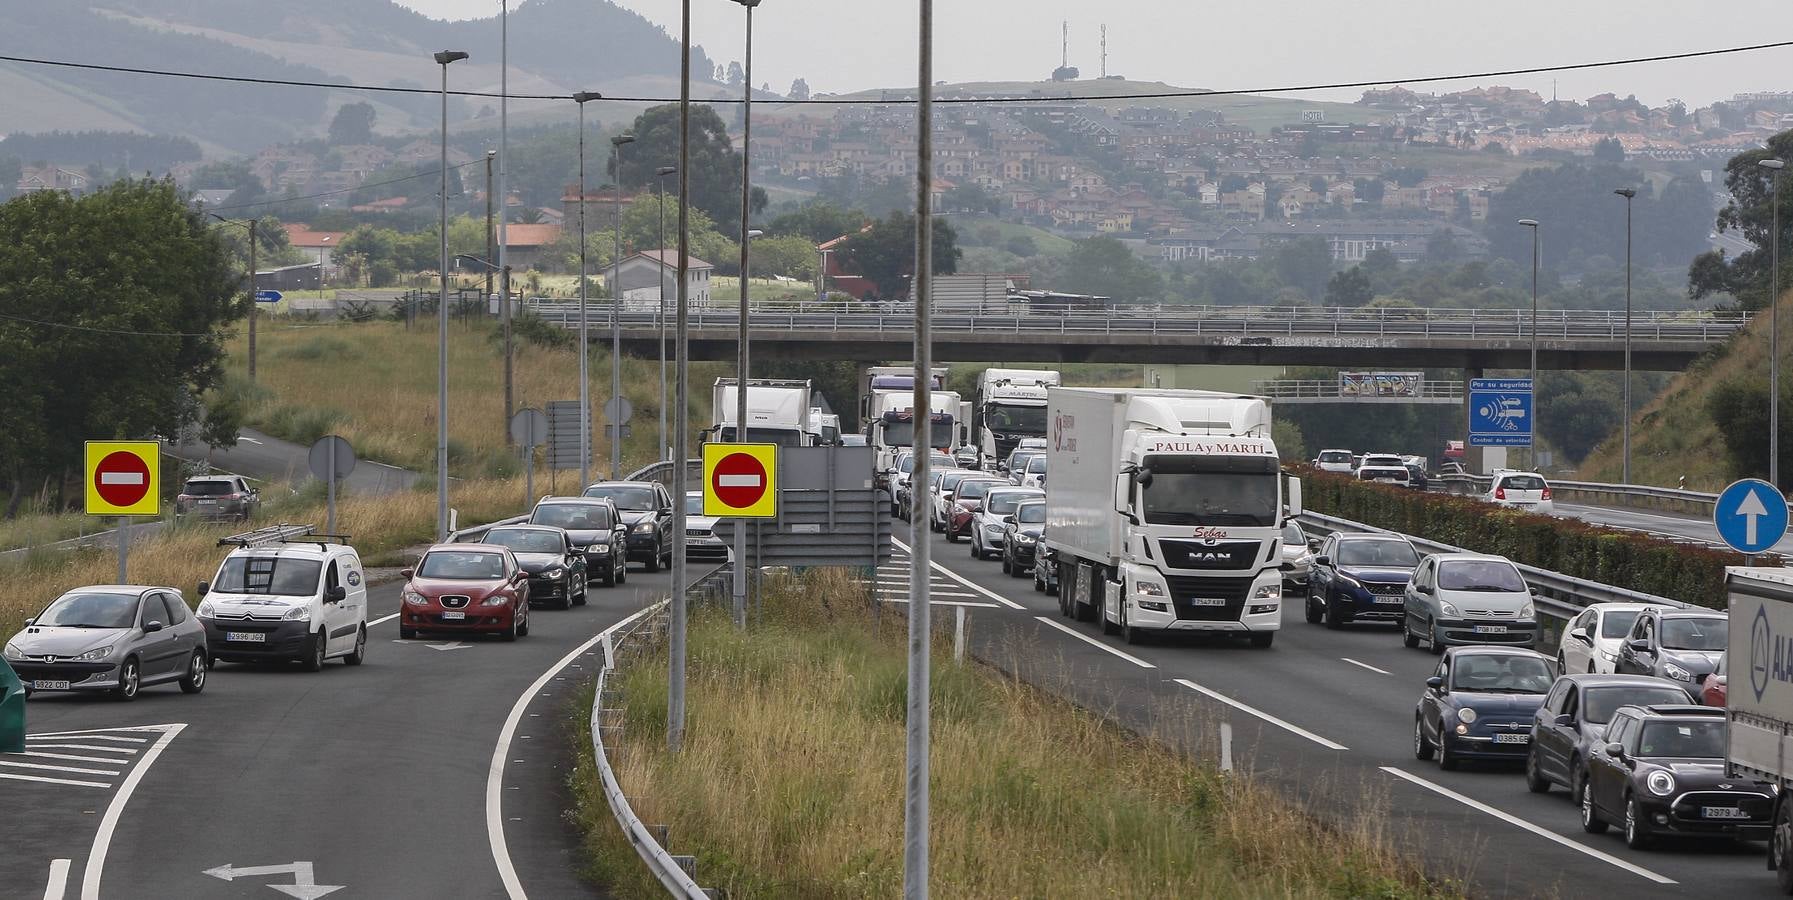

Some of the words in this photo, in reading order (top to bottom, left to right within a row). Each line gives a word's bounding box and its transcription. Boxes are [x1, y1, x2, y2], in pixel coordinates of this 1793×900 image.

[1303, 112, 1325, 120] HOTEL
[1156, 443, 1204, 452] PAULA
[1206, 445, 1213, 455] y
[1216, 443, 1265, 454] MARTÍ
[1193, 527, 1227, 538] Sebas
[1189, 552, 1231, 561] MAN
